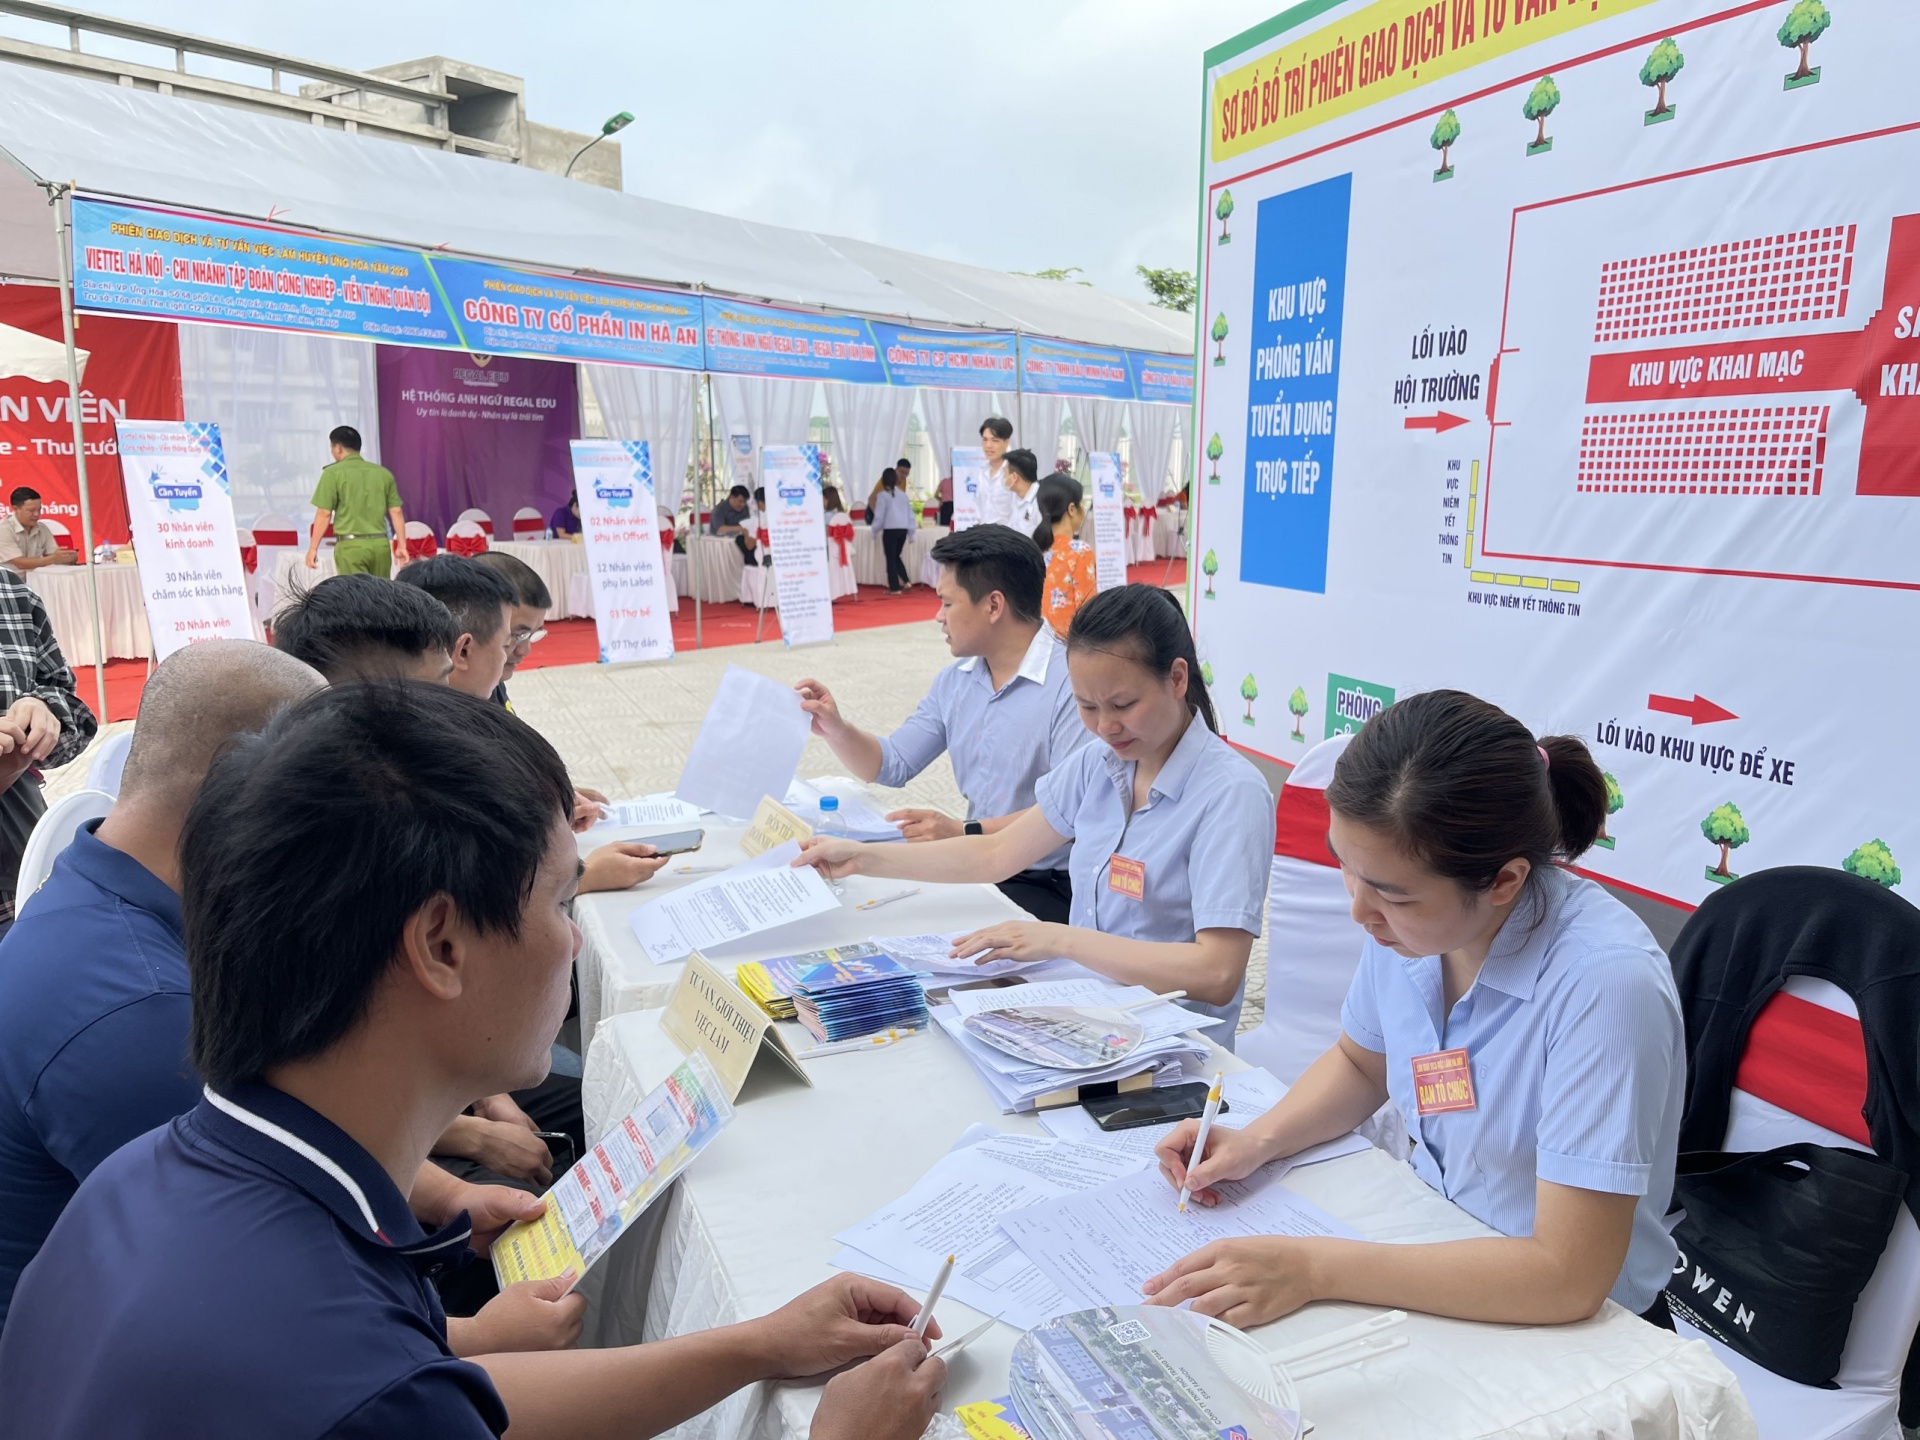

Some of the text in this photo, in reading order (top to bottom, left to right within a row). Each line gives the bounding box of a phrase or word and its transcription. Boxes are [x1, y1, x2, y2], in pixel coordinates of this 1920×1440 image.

[1222, 89, 1240, 142] SƠ
[1241, 69, 1259, 136] ĐỒ
[1262, 57, 1282, 128] BỐ
[1284, 52, 1307, 118] TRÍ
[1308, 36, 1356, 108] PHIÊN
[1359, 22, 1398, 88] GIAO
[1402, 0, 1446, 79] DỊCH
[111, 222, 142, 238] PHIÊN
[146, 229, 170, 241] GIAO
[173, 232, 198, 246] DỊCH
[200, 234, 214, 248] VÀ
[232, 238, 250, 252] VẤN
[254, 244, 274, 258] VIỆC
[278, 246, 296, 260] LÀM
[299, 250, 328, 265] HUYỆN
[85, 247, 430, 316] VIETTEL HÀ NỘI CHI NHÁNH TẬP ĐOÀN CÔNG NGHIỆP VIỄN THÔNG QUÂN ĐỘI
[1268, 277, 1327, 323] KHU VỰC
[464, 297, 518, 326] CÔNG
[522, 307, 543, 328] TY
[548, 305, 573, 332] CỔ
[628, 321, 646, 340] IN
[650, 320, 671, 343] HÀ
[676, 327, 697, 345] AN
[1412, 324, 1468, 360] LỐI VÀO
[888, 345, 916, 364] CÔNG
[918, 350, 929, 366] TY
[932, 352, 945, 367] CP
[1256, 328, 1334, 380] PHỎNG VẤN
[453, 368, 510, 383] REGAL EDU
[1629, 350, 1804, 388] KHU VỰC KHAI MẠC
[402, 388, 557, 408] HỆ THỐNG ANH NGỮ REGAL EDU
[1394, 370, 1480, 409] HỘI TRƯỜNG
[36, 390, 126, 423] VIÊN
[416, 408, 428, 418] Uy
[1251, 390, 1332, 442] TUYỂN DỤNG
[1256, 450, 1320, 500] TRỰC TIẾP
[1448, 459, 1461, 471] KHU
[1446, 478, 1459, 491] VỰC
[1443, 496, 1459, 509] NIÊM
[157, 521, 214, 533] 30 Nhân viên
[590, 516, 647, 526] 02 Nhân viên
[1444, 513, 1455, 527] YẾT
[165, 539, 214, 549] kinh doanh
[594, 531, 650, 543] phụ in Offset
[1438, 533, 1459, 546] THÔNG
[597, 562, 652, 573] 12 Nhân viên
[1442, 553, 1452, 564] TIN
[166, 569, 222, 582] 30 Nhân viên
[602, 577, 653, 591] phụ in Label
[152, 584, 244, 600] chăm sóc khách hàng
[1468, 592, 1581, 617] KHU VỰC NIÊM YẾT THÔNG TIN
[175, 618, 230, 631] 20 Nhân viên
[1598, 718, 1795, 786] LỐI VÀO KHU VỰC ĐỂ XE
[689, 970, 701, 986] TƯ
[716, 996, 733, 1023] GIỚI
[732, 1012, 757, 1044] THIỆU
[694, 1009, 730, 1054] VIỆC LÀM
[1419, 1074, 1469, 1105] BAN TỔ CHỨC
[1161, 1360, 1177, 1376] TRANG
[1178, 1367, 1199, 1388] FASHION
[1206, 1408, 1222, 1425] CÔNG
